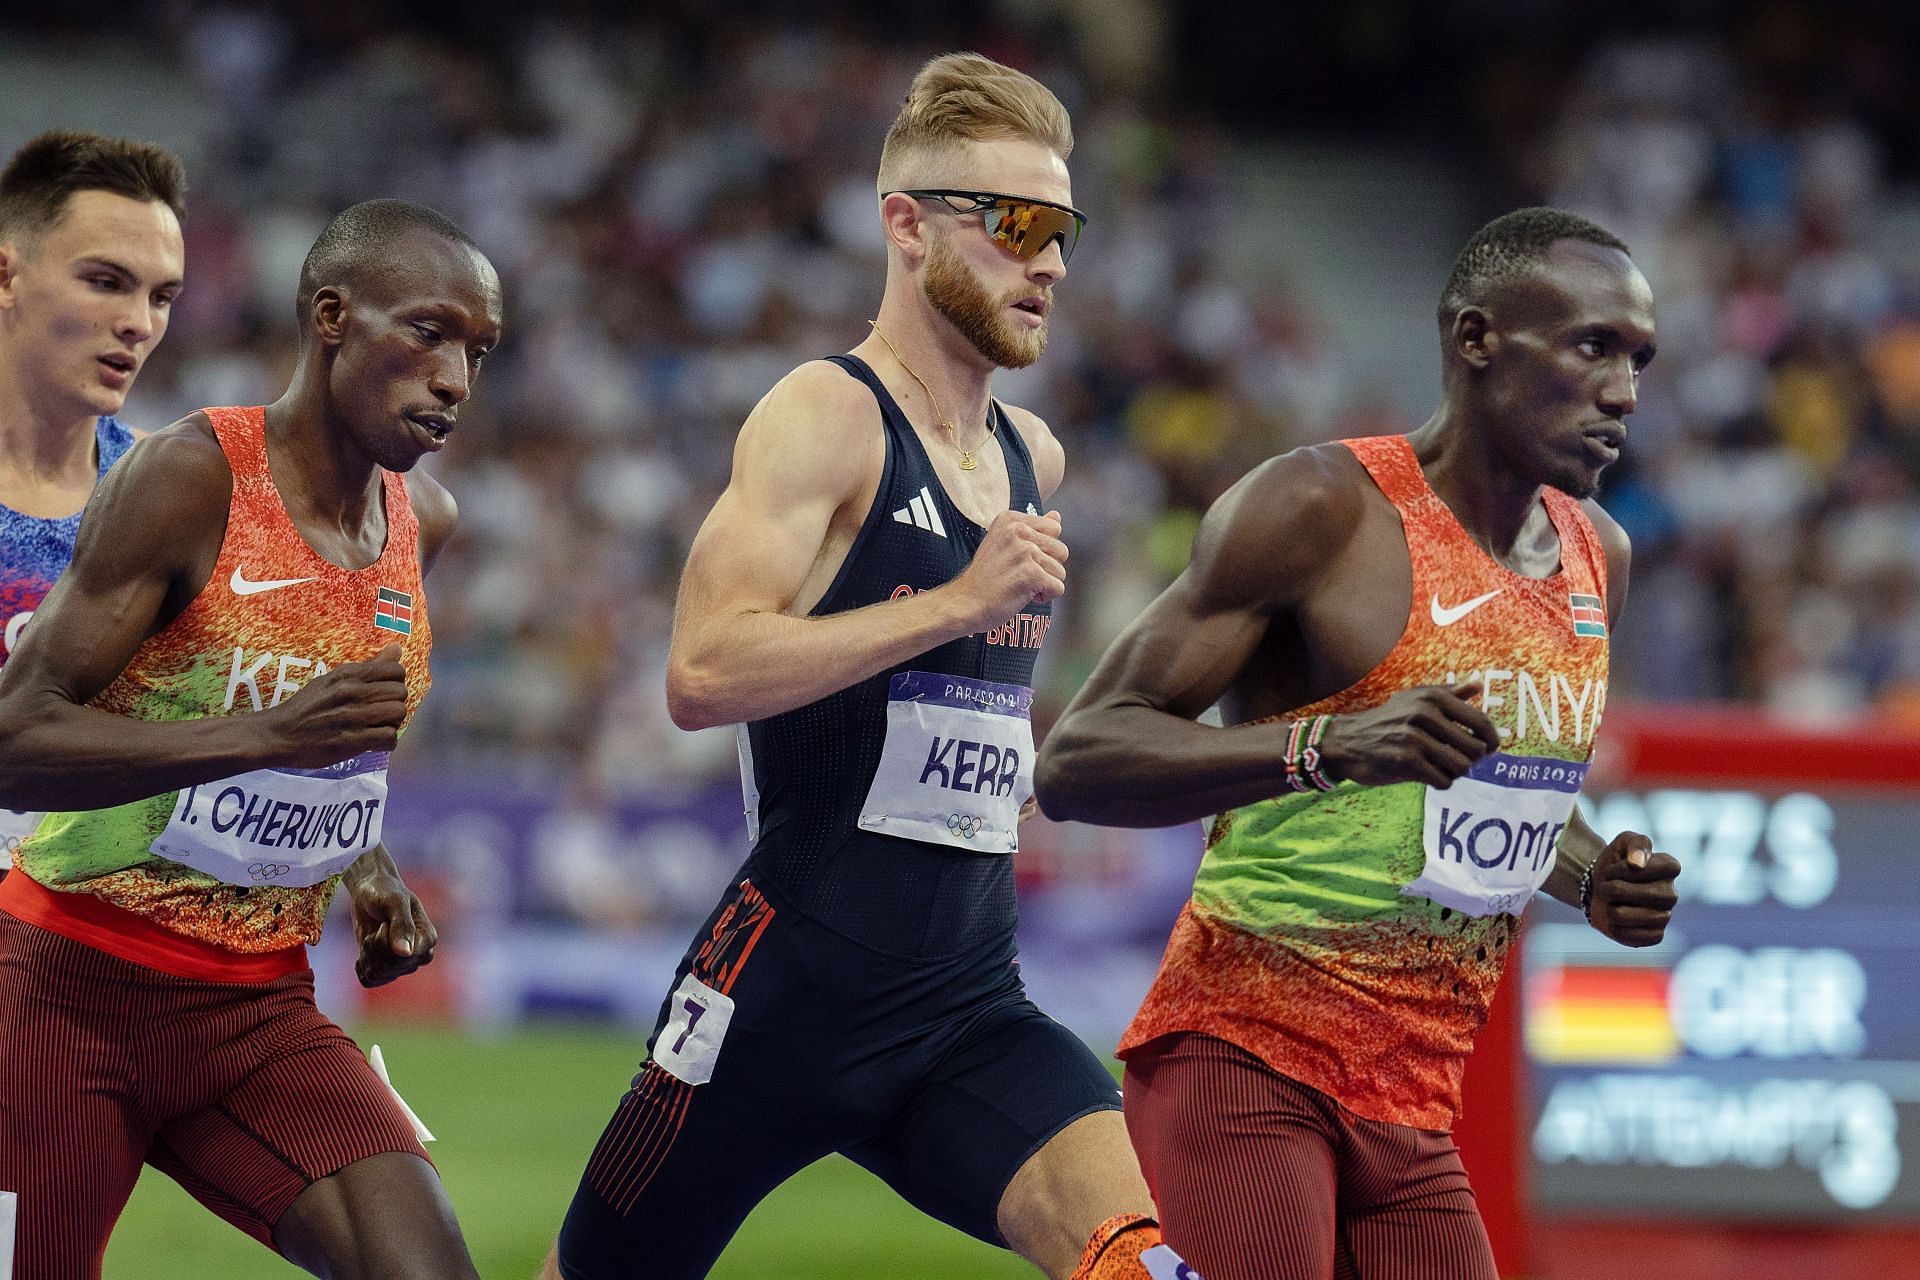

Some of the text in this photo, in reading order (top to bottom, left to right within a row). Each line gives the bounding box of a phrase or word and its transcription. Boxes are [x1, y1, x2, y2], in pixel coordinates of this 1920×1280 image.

[1446, 669, 1606, 746] ENYA
[918, 736, 1020, 797] KERR
[671, 996, 707, 1056] 7
